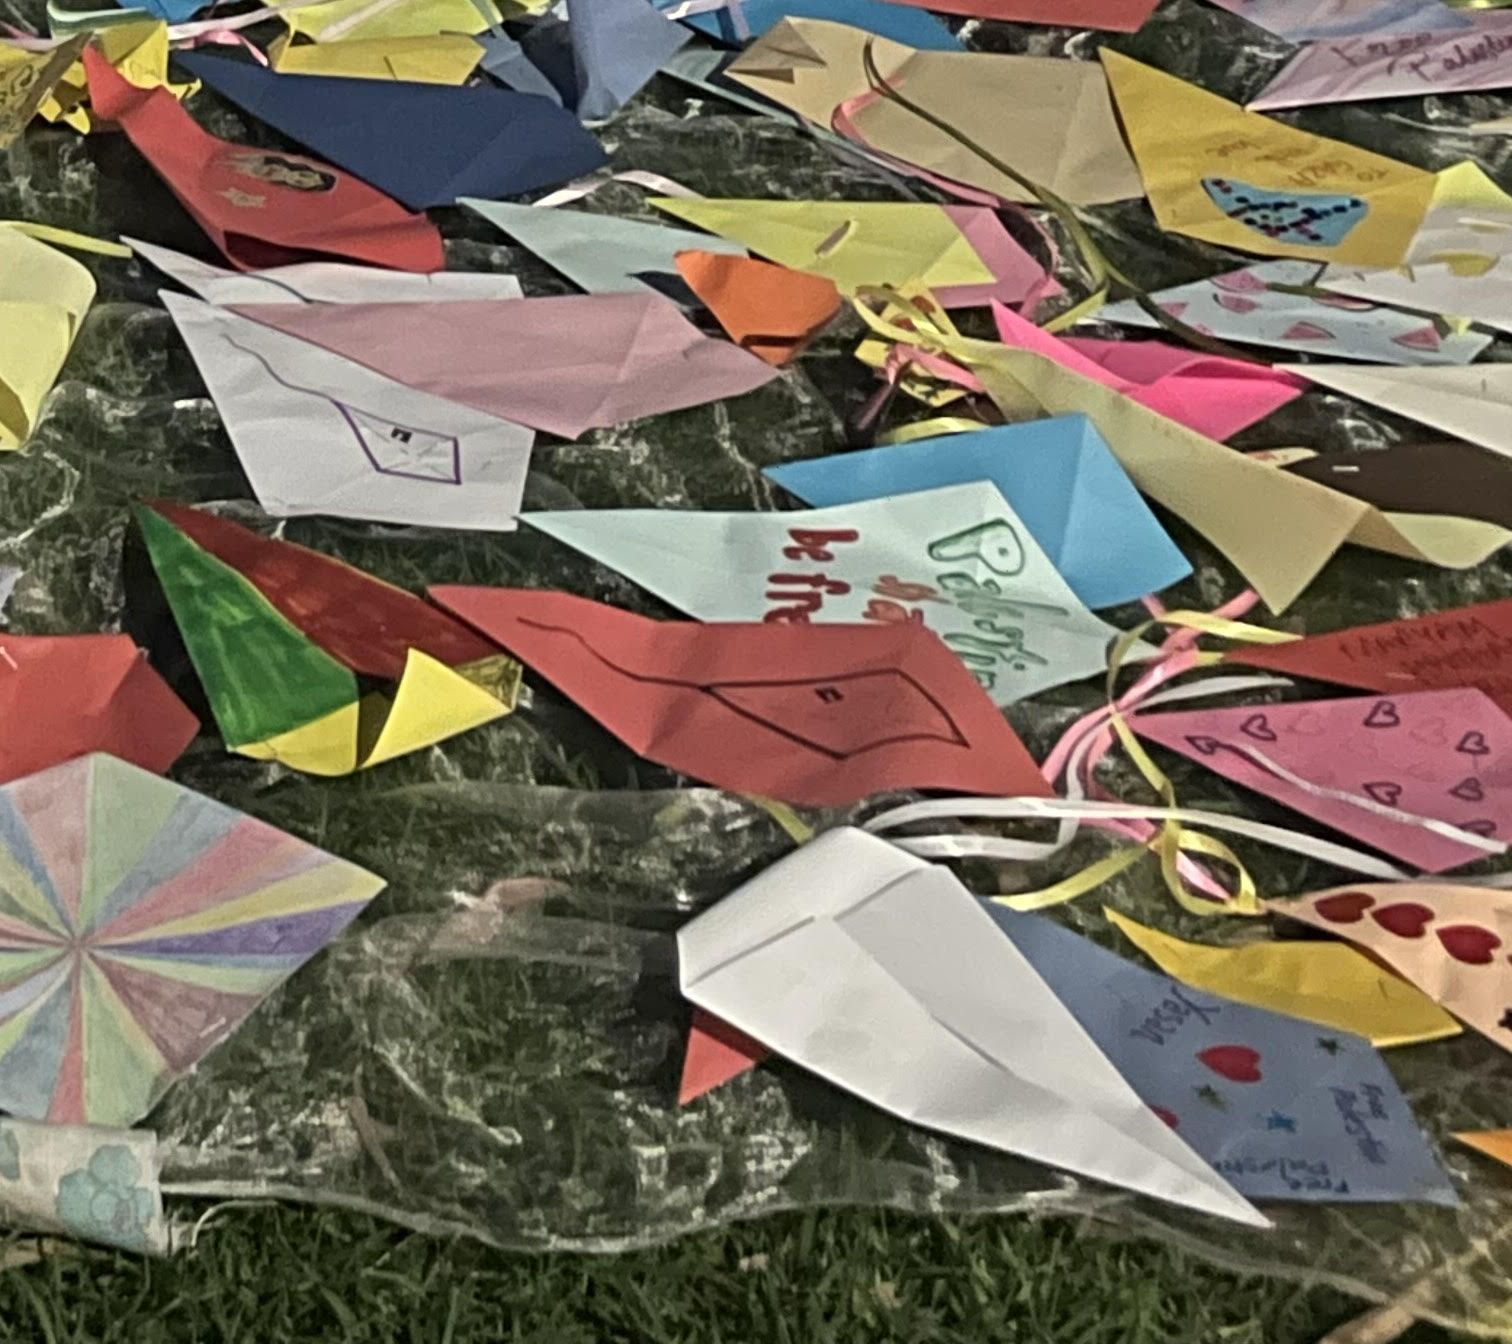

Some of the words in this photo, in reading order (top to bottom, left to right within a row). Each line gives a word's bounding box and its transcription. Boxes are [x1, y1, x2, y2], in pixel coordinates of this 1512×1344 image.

[782, 526, 862, 562] be
[763, 572, 850, 624] fre
[928, 518, 1045, 693] Palestin
